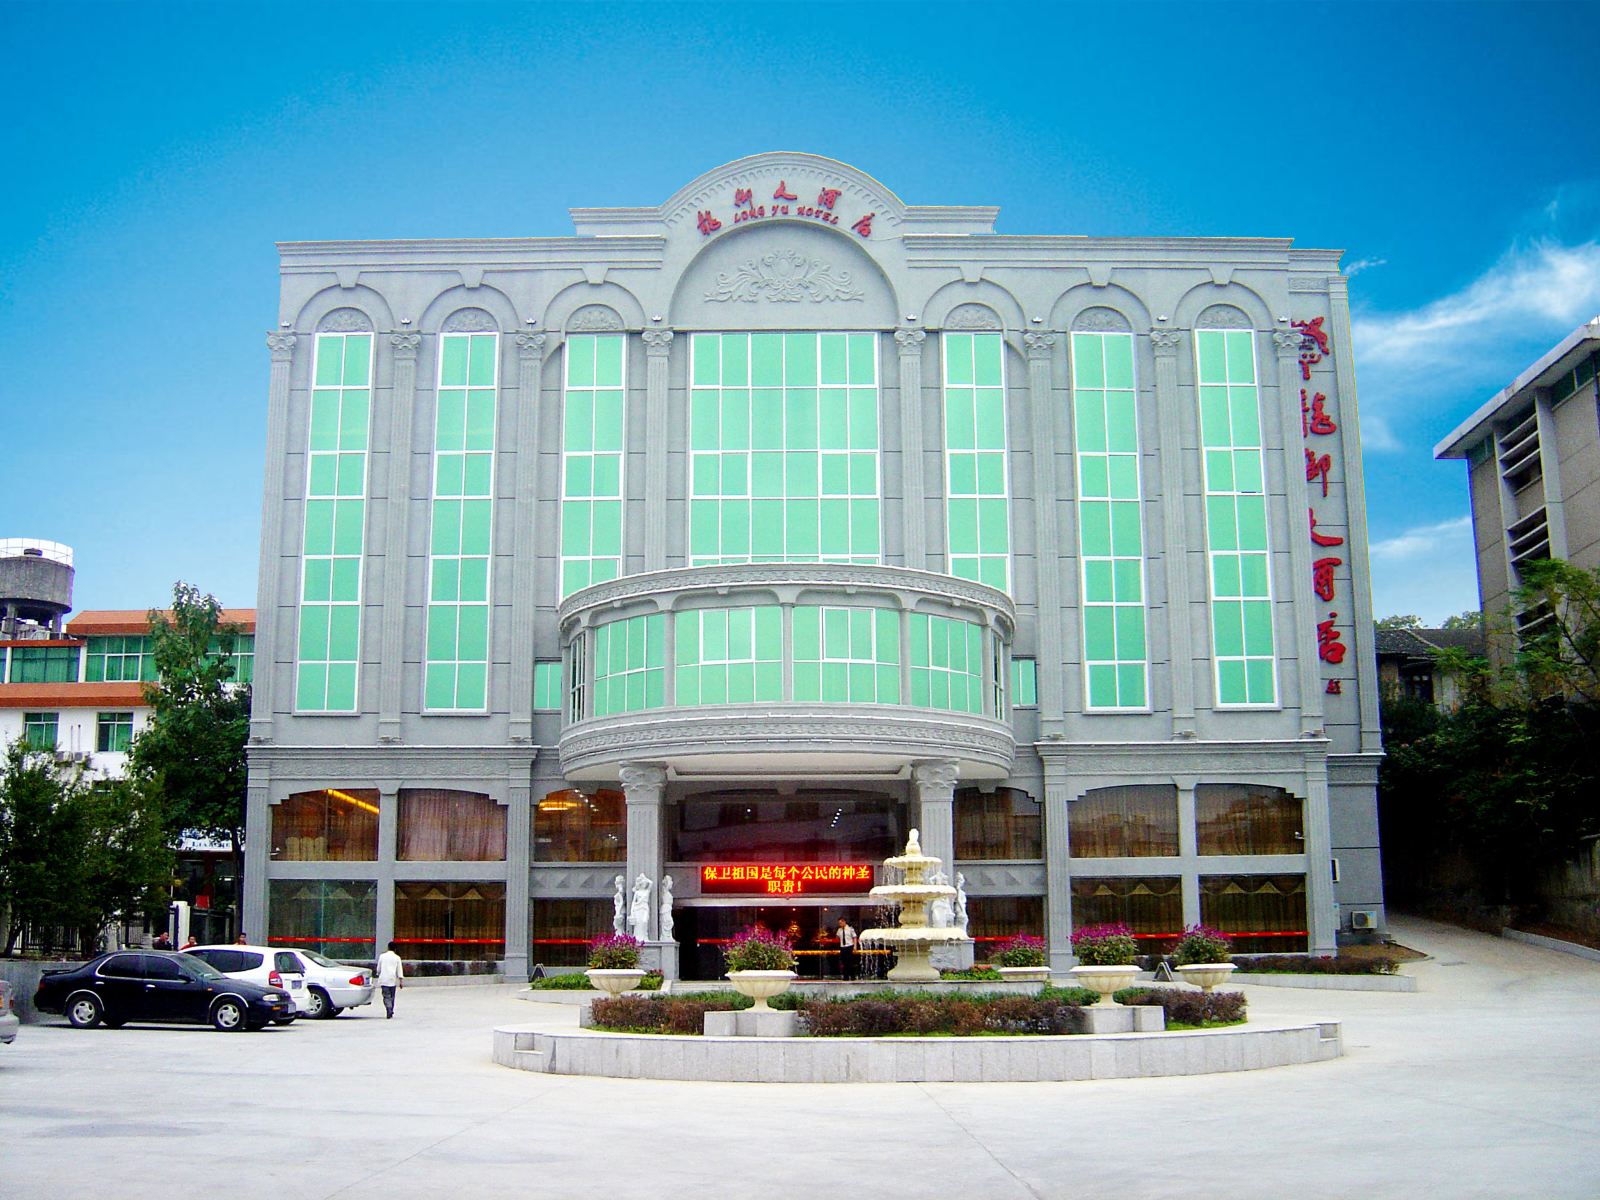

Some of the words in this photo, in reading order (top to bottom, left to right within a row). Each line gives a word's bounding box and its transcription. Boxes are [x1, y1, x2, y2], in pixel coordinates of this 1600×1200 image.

[734, 206, 765, 223] LONG
[772, 204, 789, 216] YU
[797, 206, 839, 225] HOTEL
[704, 865, 870, 880] 保卫祖国是每个公民的神圣
